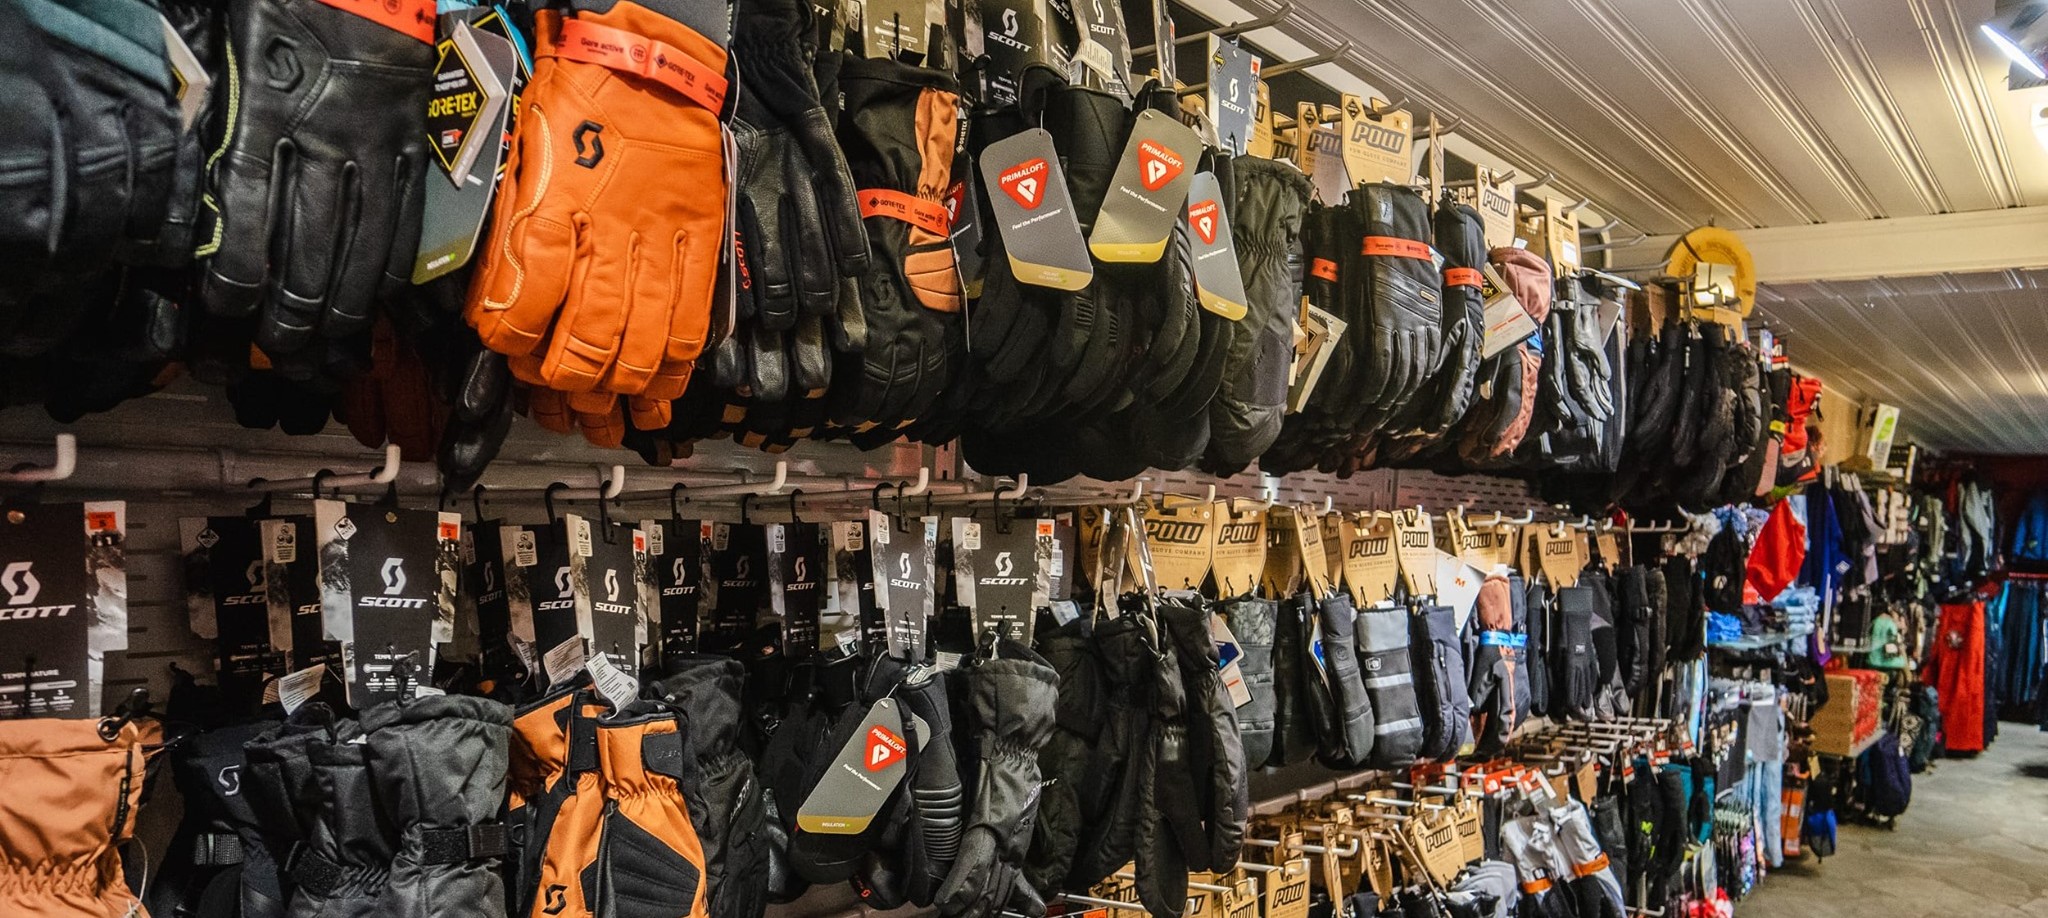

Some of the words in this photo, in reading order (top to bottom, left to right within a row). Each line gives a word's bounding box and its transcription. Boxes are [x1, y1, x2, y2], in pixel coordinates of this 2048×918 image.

[1091, 23, 1115, 36] SCOTT
[987, 31, 1032, 52] SCOTT
[1221, 99, 1246, 115] SCOTT
[1351, 121, 1406, 154] POW
[1140, 142, 1182, 169] PRIMALOFT
[1001, 162, 1045, 184] PRIMALOFT
[1482, 188, 1511, 217] POW
[1146, 518, 1206, 545] POW
[1217, 521, 1262, 545] POW
[1402, 530, 1429, 548] POW
[1349, 537, 1389, 559] POW
[1462, 533, 1492, 550] POW
[1545, 540, 1573, 556] POW
[662, 586, 695, 596] SCOTT
[786, 582, 816, 591] SCOTT
[890, 578, 921, 590] SCOTT
[223, 595, 268, 606] SCO
[358, 597, 427, 608] SCOTT
[538, 600, 574, 611] SCO
[594, 602, 632, 615] SCOTT
[0, 604, 76, 620] COTT
[871, 728, 907, 754] PRIMALOFT
[1425, 825, 1453, 853] POW
[1272, 880, 1306, 909] POW
